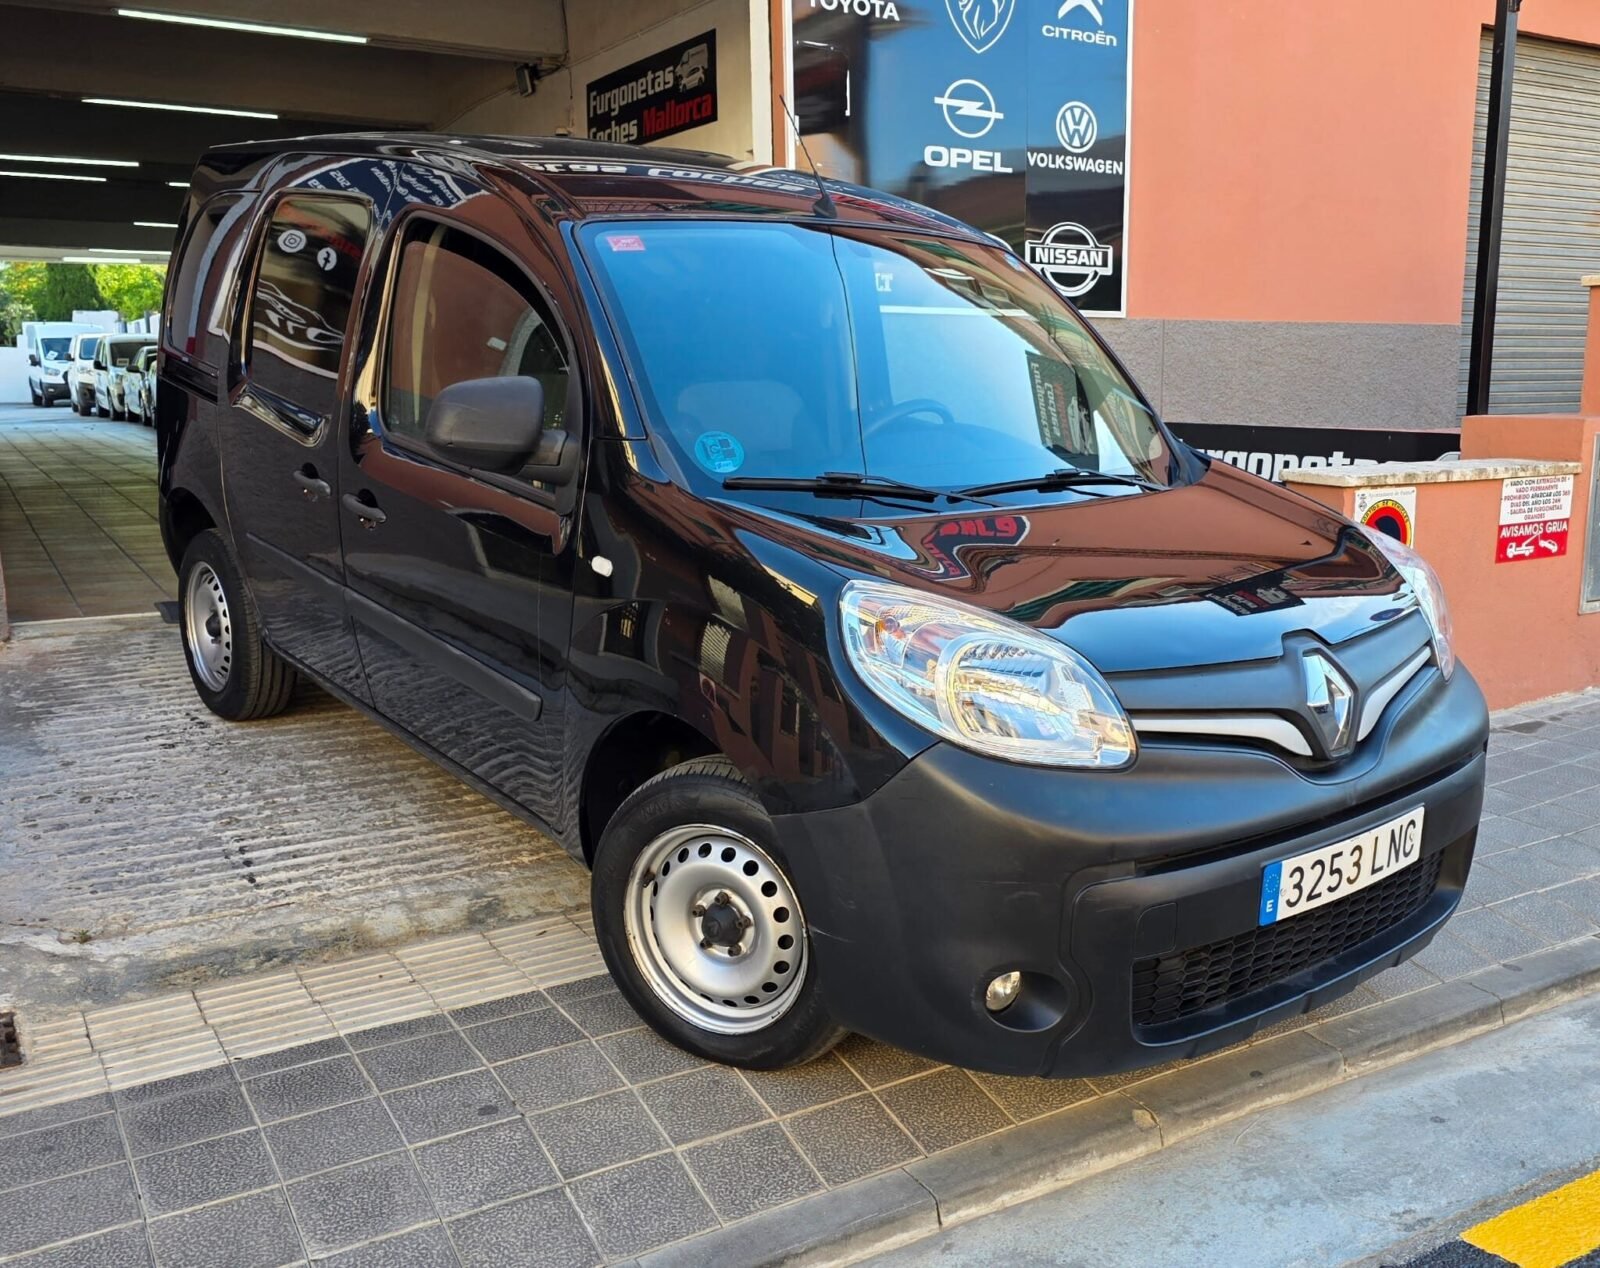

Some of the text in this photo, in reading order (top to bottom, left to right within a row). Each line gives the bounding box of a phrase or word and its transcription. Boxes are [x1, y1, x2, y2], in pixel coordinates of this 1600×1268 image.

[589, 66, 674, 118] Furgonetas
[642, 93, 713, 137] Mallorca
[924, 145, 1013, 173] OPEL
[1027, 151, 1124, 175] VOLKSWAGEN
[1035, 247, 1103, 267] NISSAN
[1500, 520, 1568, 539] AVISAMOS GRUA
[1285, 818, 1417, 908] 3253 LNC
[1265, 900, 1274, 913] E
